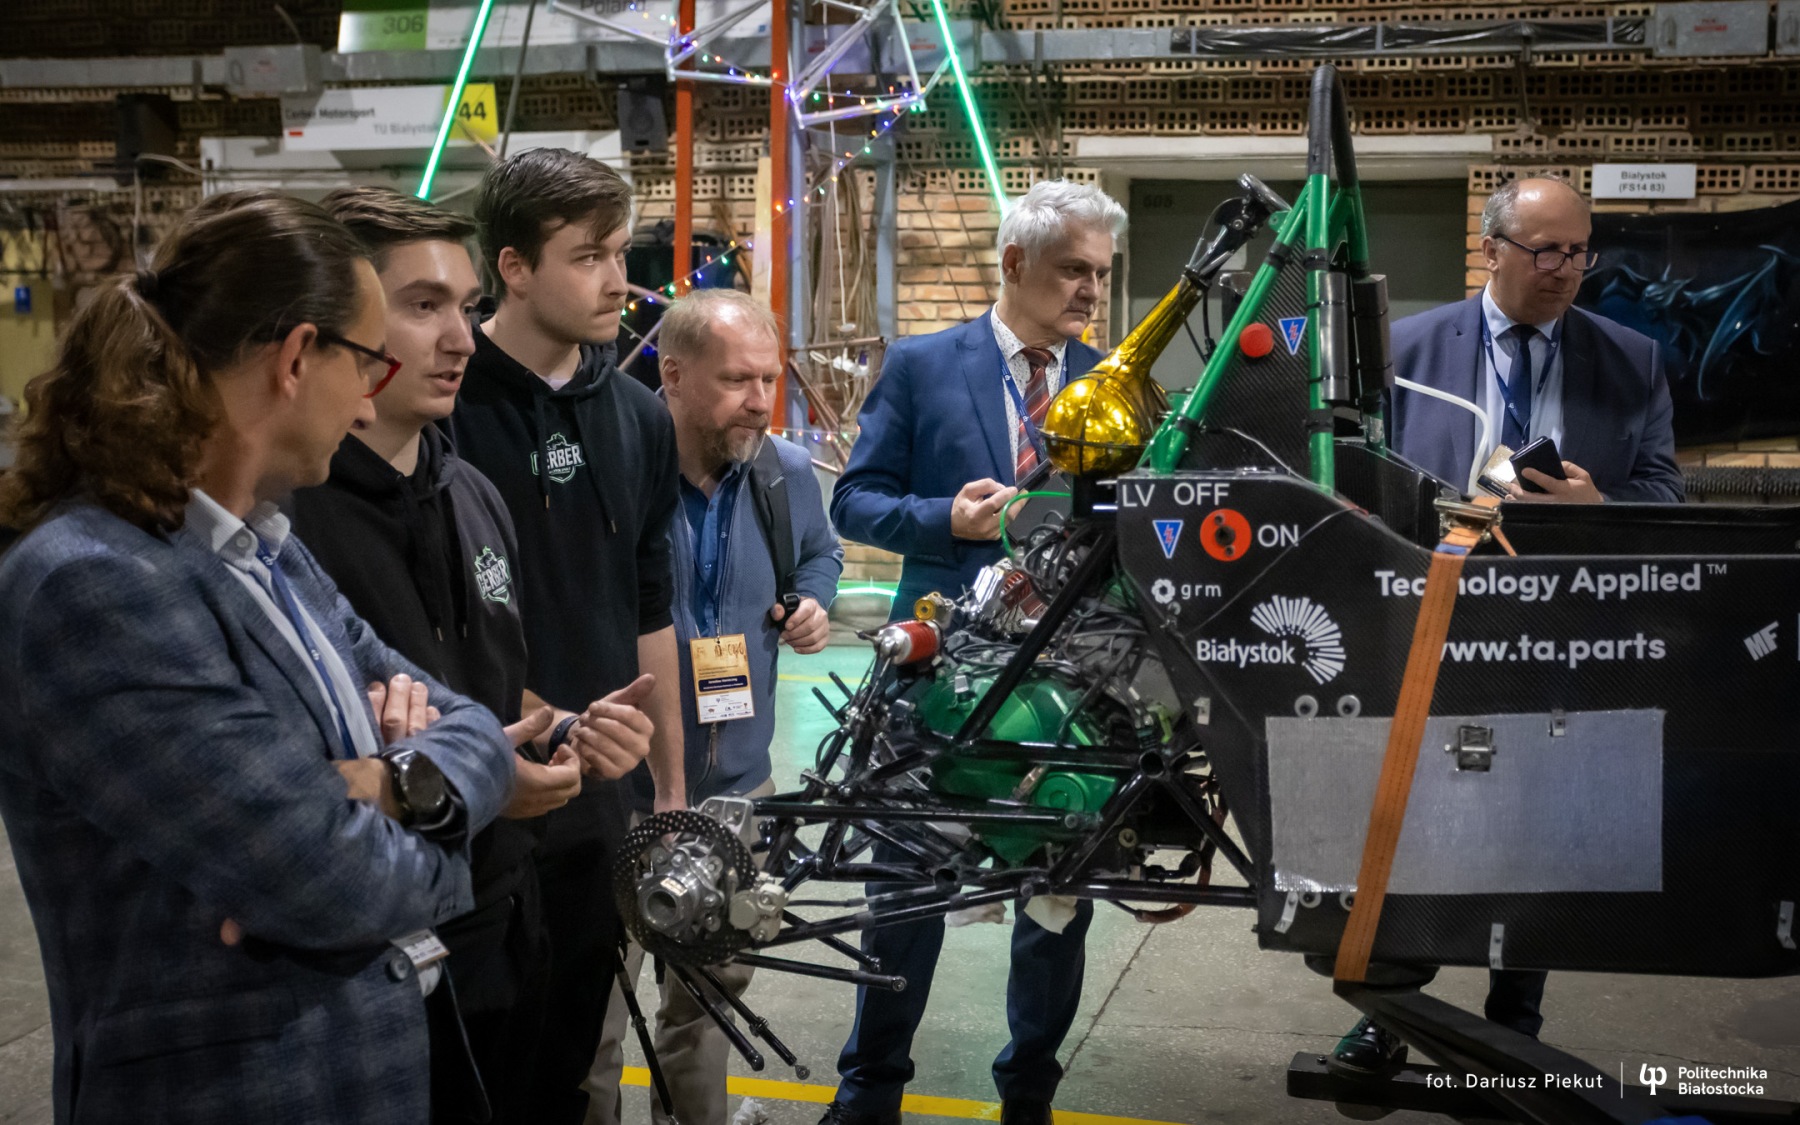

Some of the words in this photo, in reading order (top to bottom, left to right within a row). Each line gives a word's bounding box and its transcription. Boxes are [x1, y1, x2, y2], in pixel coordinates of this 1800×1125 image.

[382, 15, 424, 35] 306
[319, 107, 375, 121] Motorsport
[1122, 484, 1156, 507] LV
[1173, 482, 1230, 506] OFF
[1257, 524, 1299, 547] ON
[1181, 584, 1222, 600] grm
[1569, 563, 1701, 600] Applied
[1196, 638, 1296, 669] Białystok
[1440, 633, 1667, 669] ww.ta.parts
